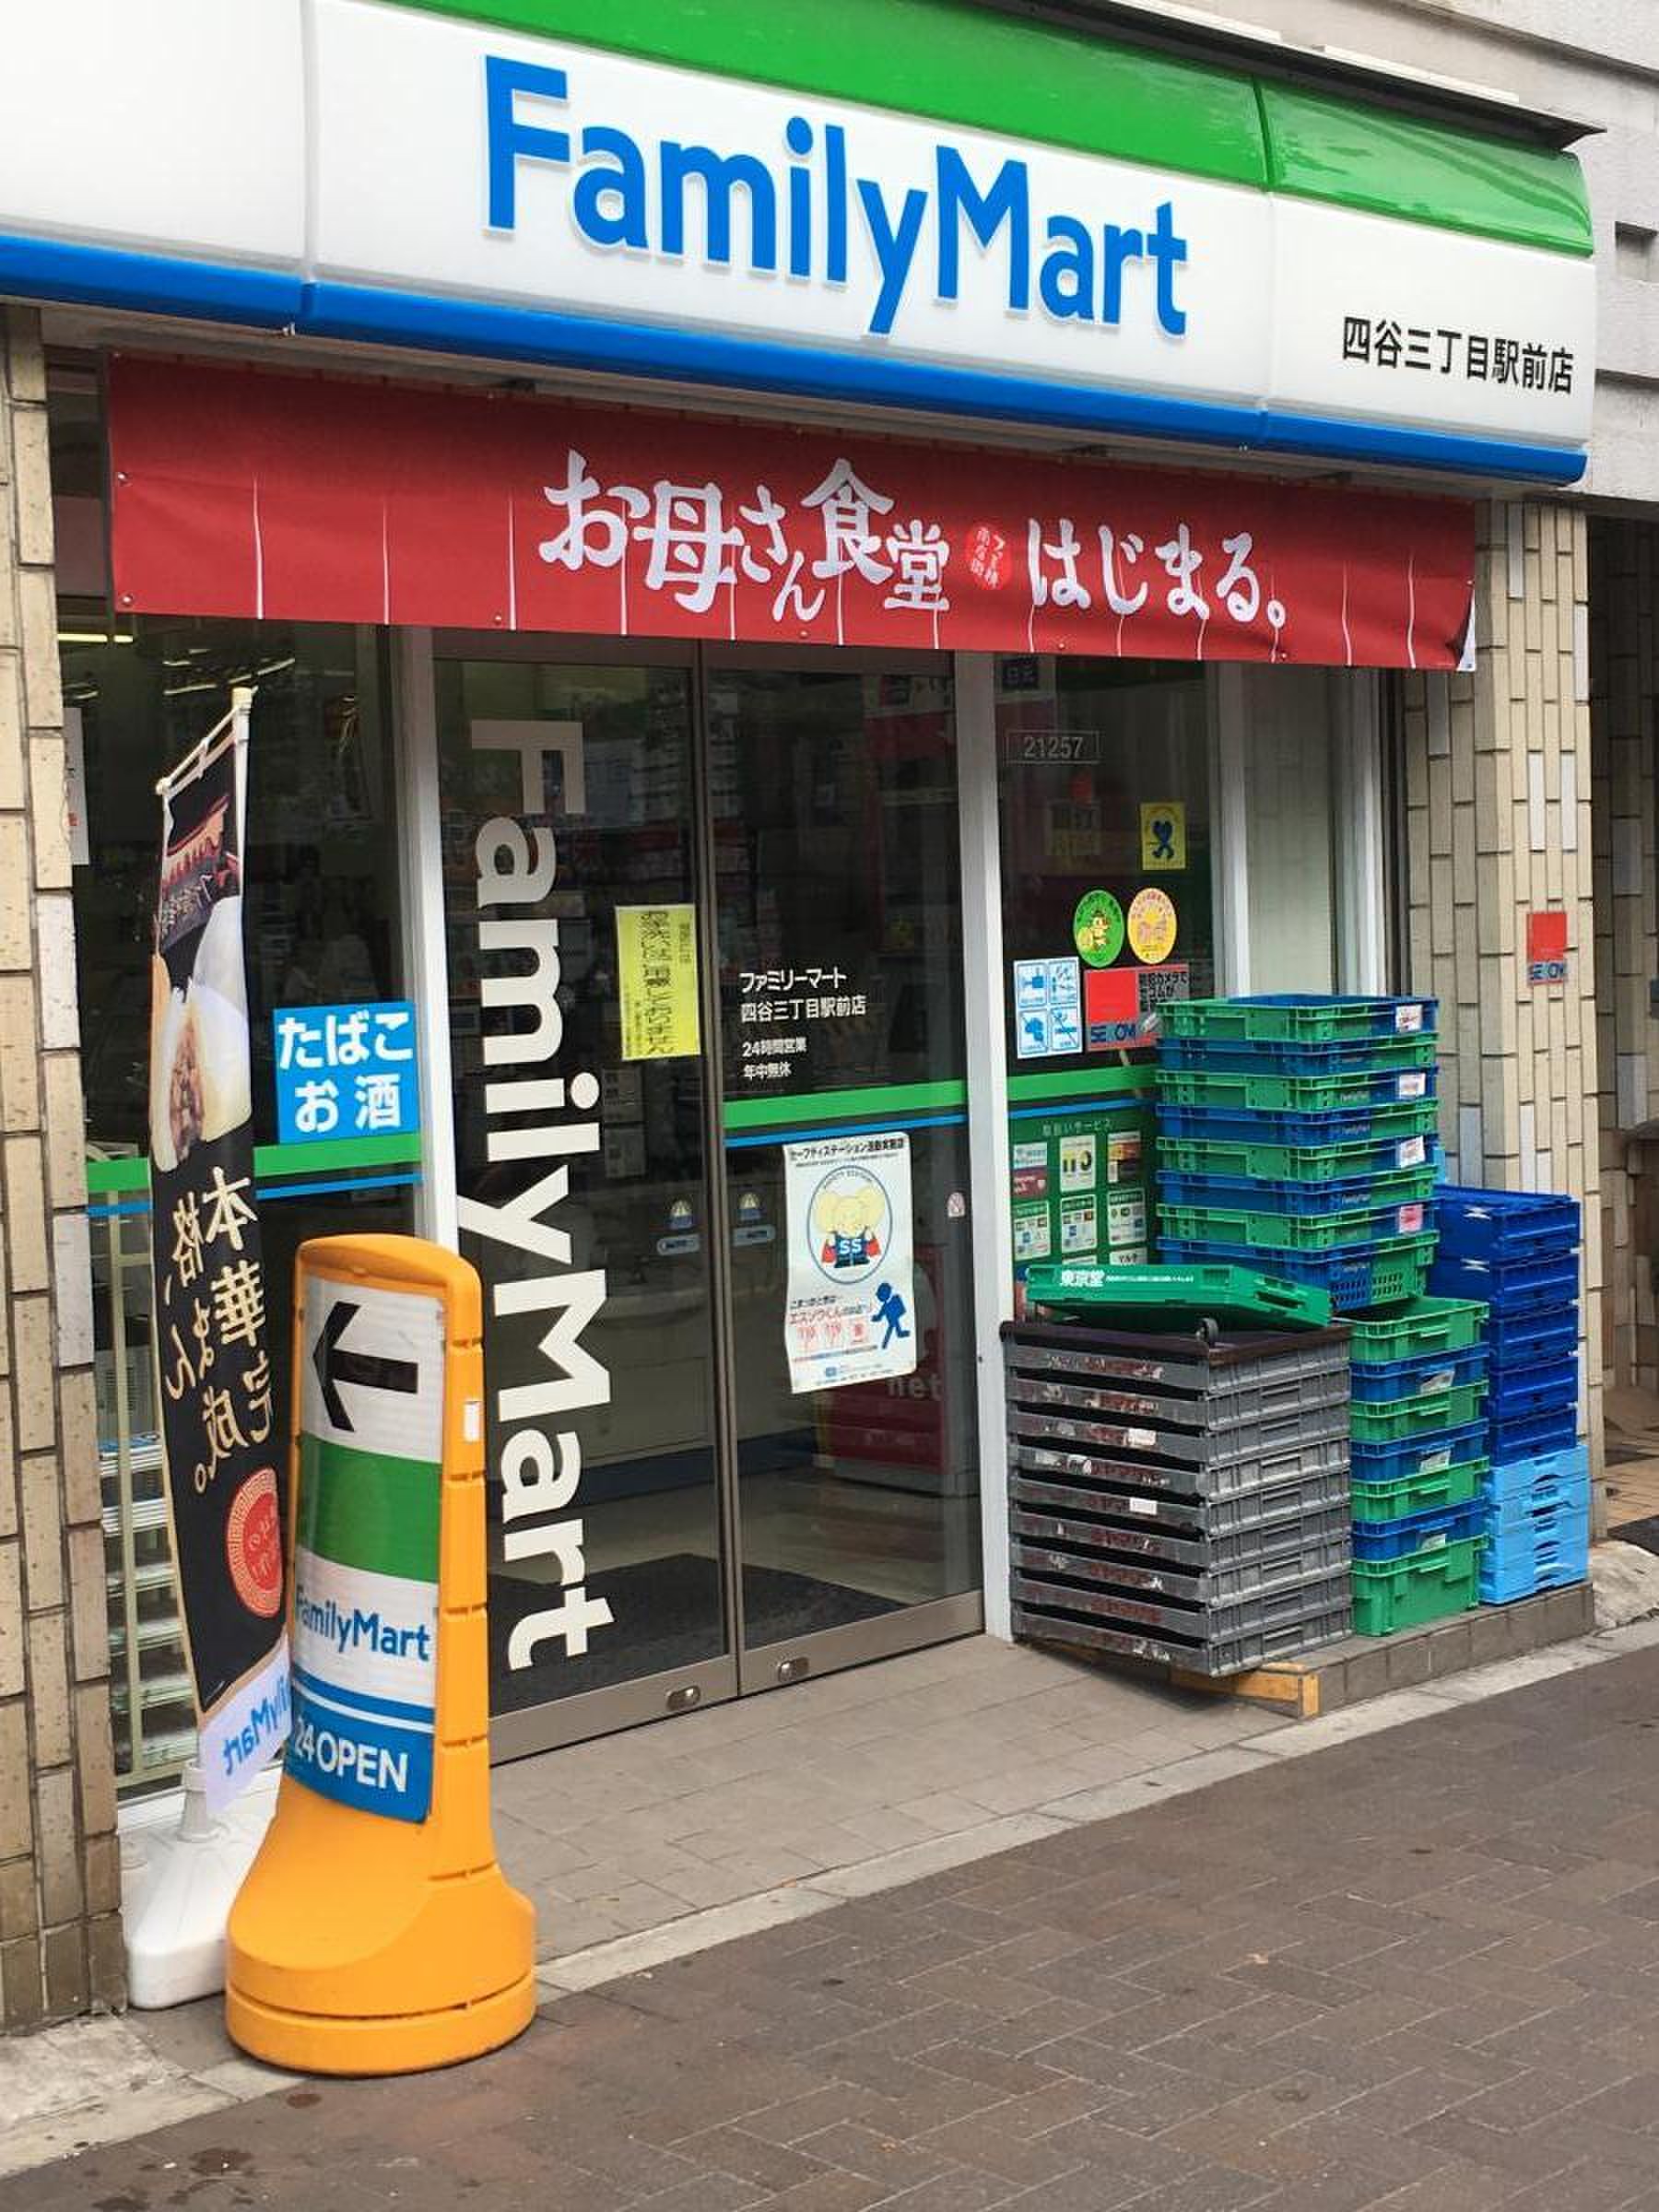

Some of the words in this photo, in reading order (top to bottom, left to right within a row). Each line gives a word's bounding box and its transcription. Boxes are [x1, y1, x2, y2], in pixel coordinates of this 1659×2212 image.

[484, 54, 1188, 337] FamilyMart
[1342, 315, 1574, 395] 四谷三丁目駅前店
[538, 449, 950, 623] お母さん食堂
[1027, 518, 1288, 629] はじまる。
[1023, 736, 1085, 759] 21257
[739, 967, 847, 994] ファミリーマート
[740, 994, 866, 1023] 四谷三丁目駅前店
[278, 1009, 413, 1070] たばこ
[294, 1072, 401, 1133] お酒
[457, 719, 616, 1673] FamilyMart
[840, 1238, 863, 1254] SS
